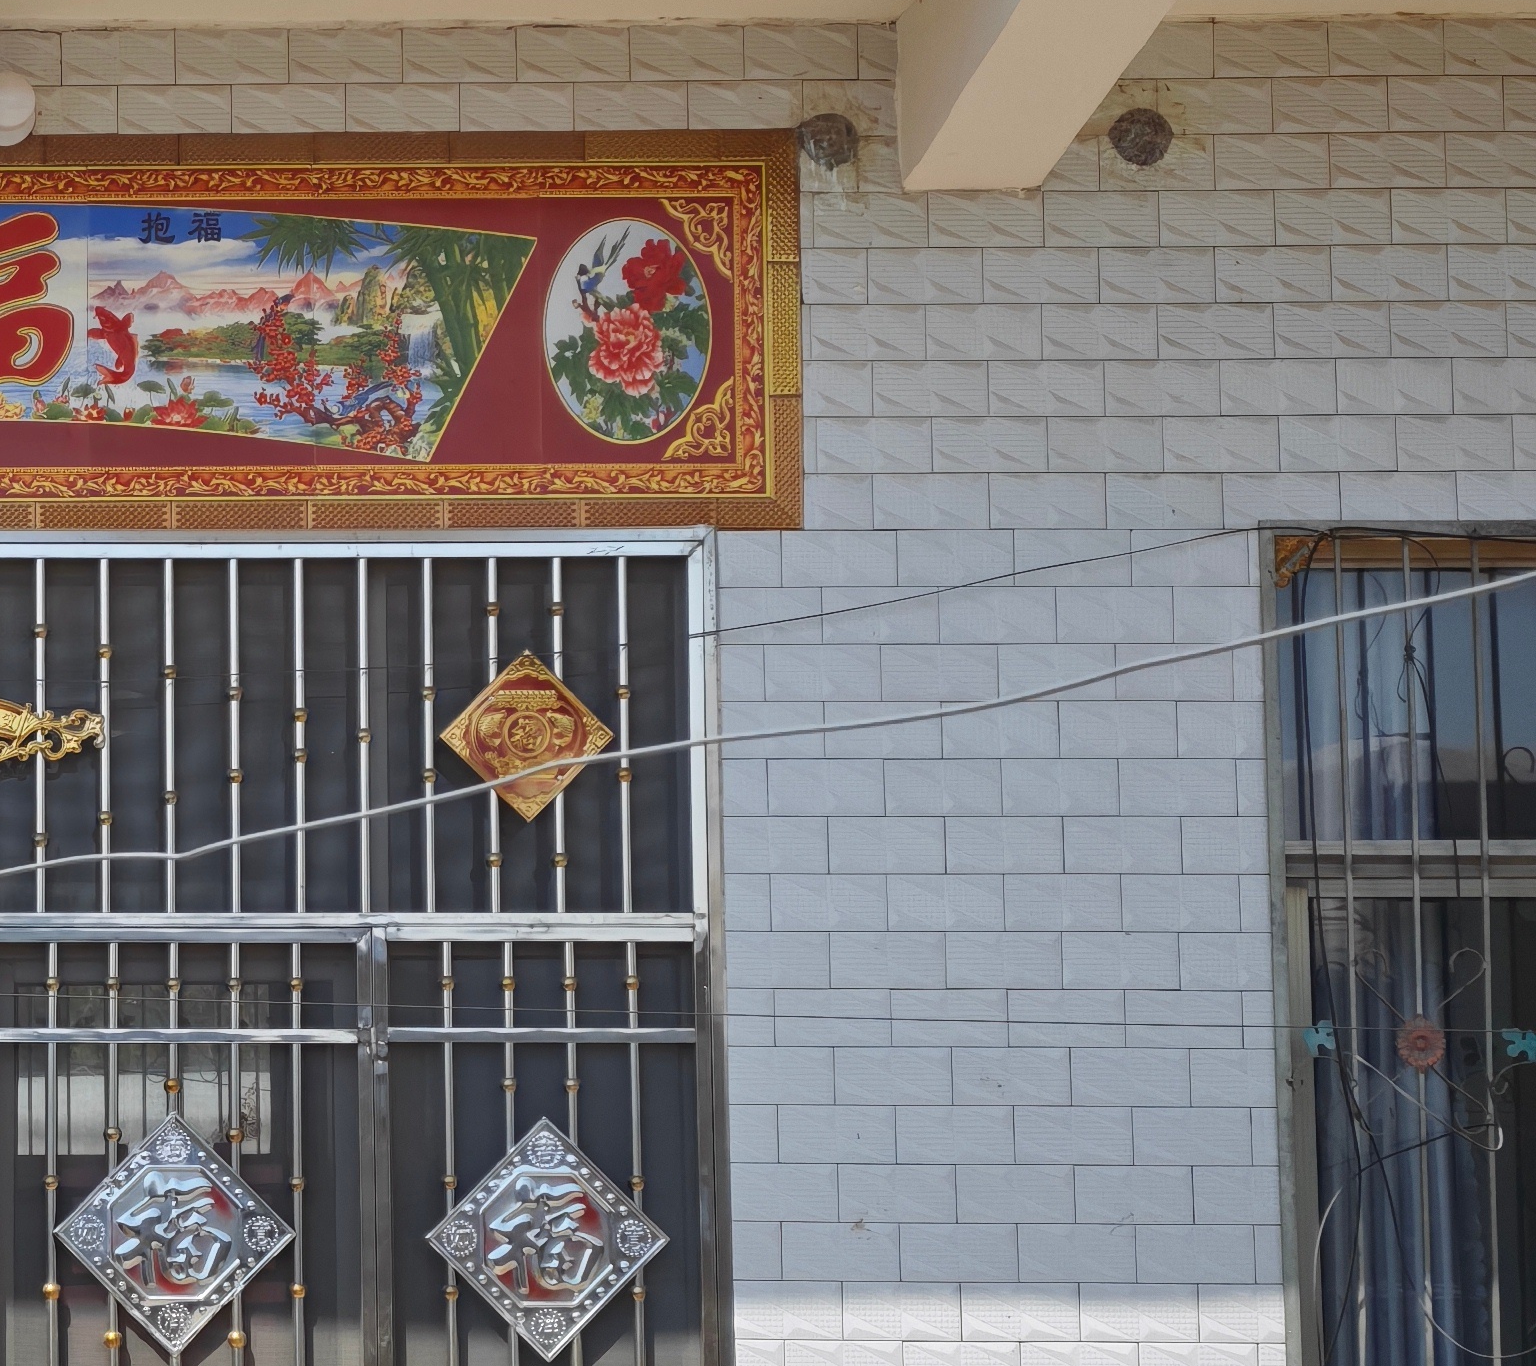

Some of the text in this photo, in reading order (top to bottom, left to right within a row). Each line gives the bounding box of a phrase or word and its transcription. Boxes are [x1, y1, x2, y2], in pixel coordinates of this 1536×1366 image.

[138, 211, 222, 244] 抱福
[114, 1171, 232, 1288] 福
[487, 1176, 604, 1295] 福
